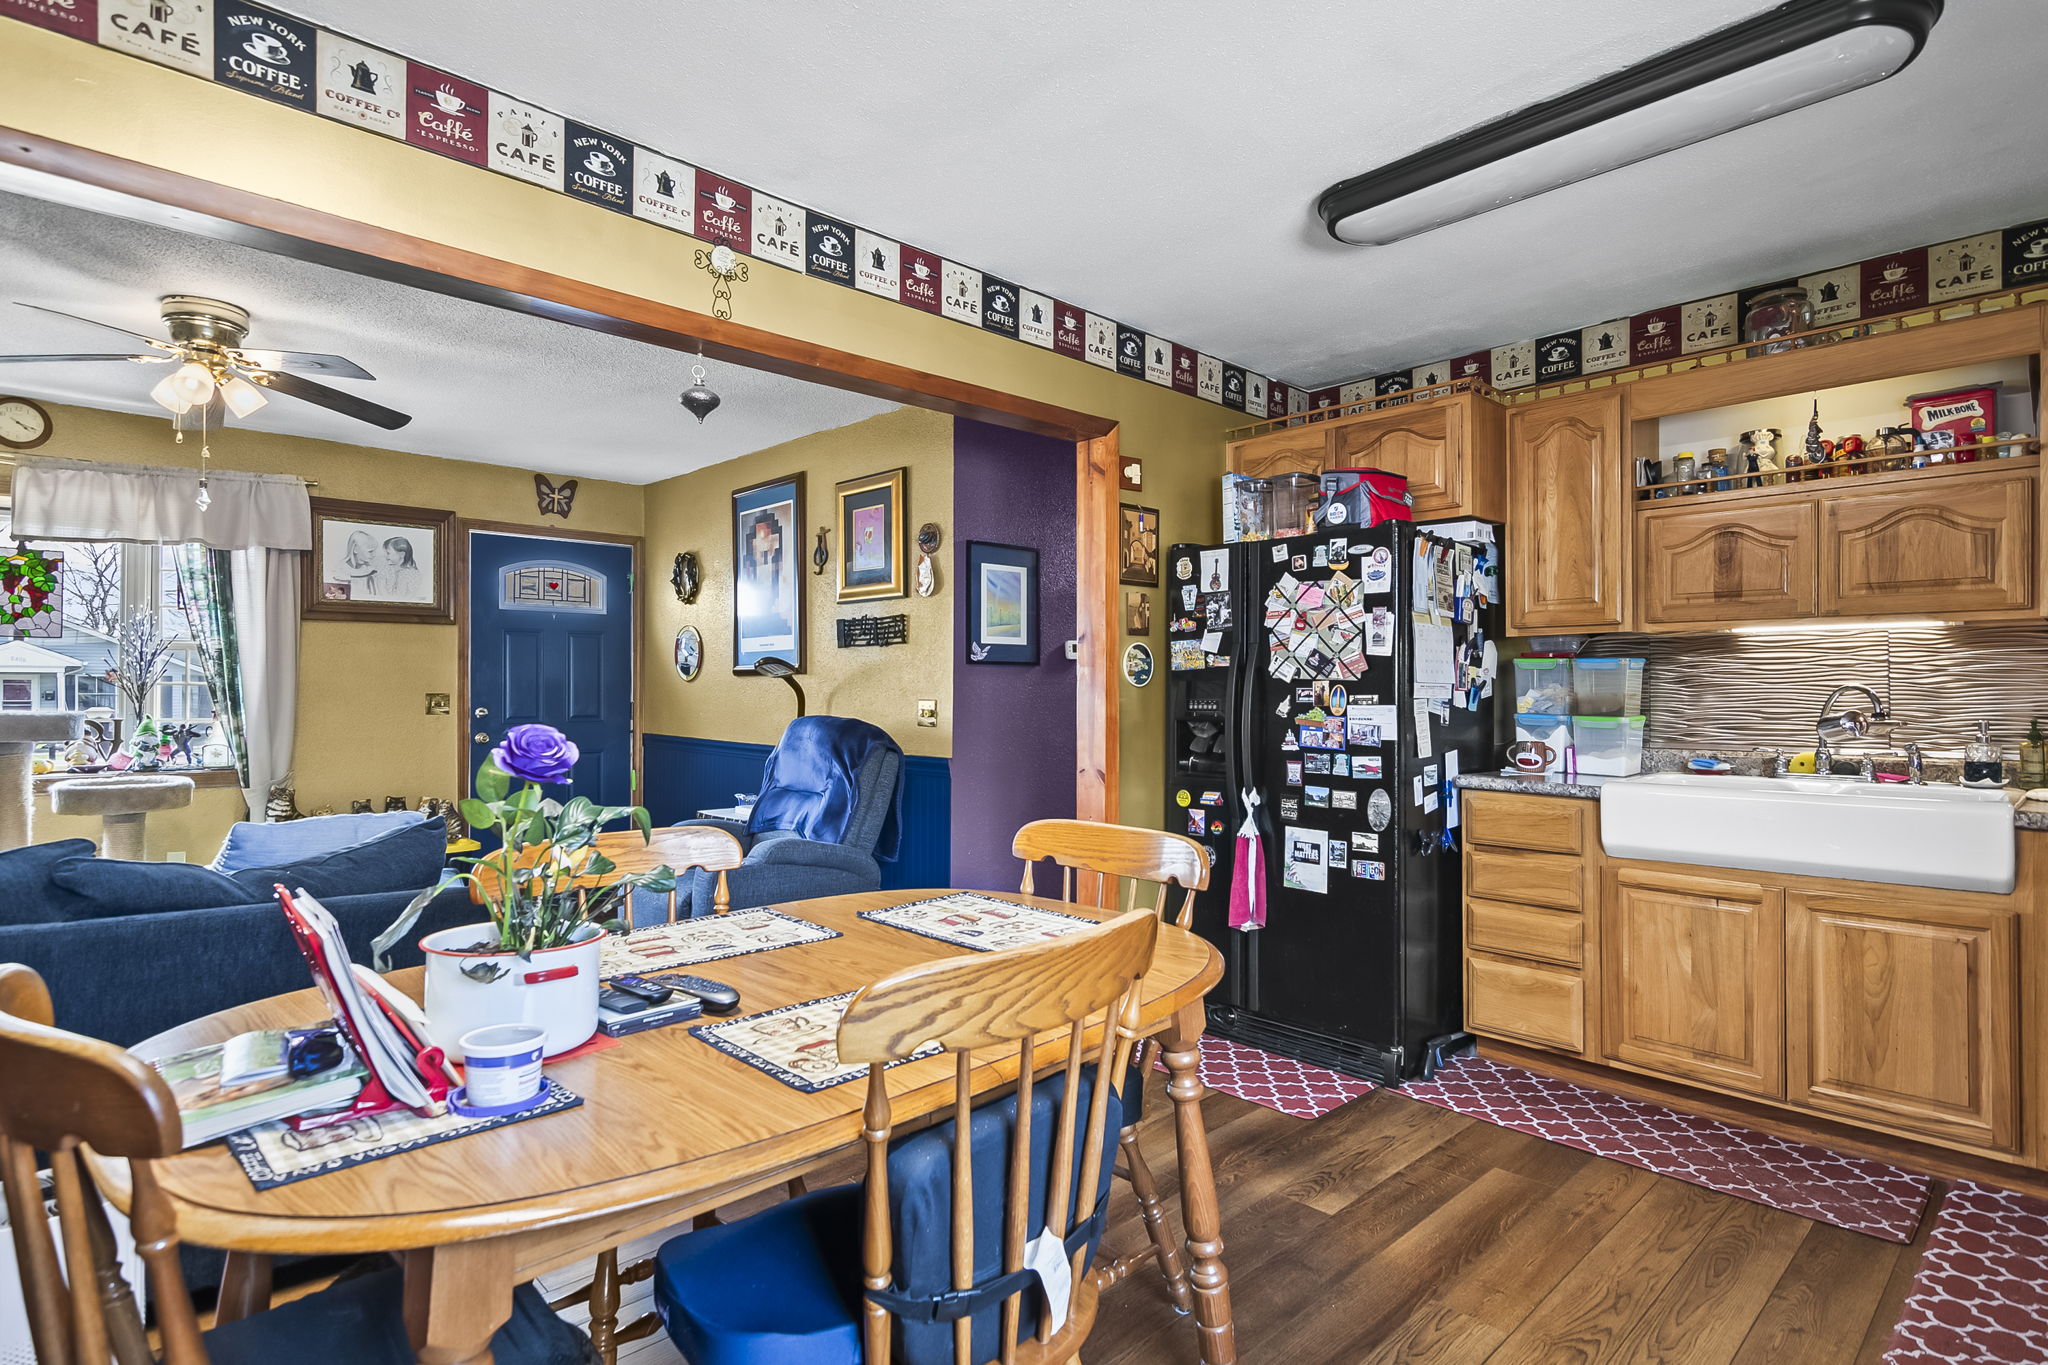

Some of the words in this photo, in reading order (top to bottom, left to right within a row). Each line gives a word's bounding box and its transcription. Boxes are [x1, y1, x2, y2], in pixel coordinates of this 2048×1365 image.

[110, 13, 200, 56] CAFÉ
[227, 15, 264, 27] NEW
[267, 19, 306, 52] YORK
[228, 55, 302, 90] COFFEE
[270, 83, 304, 100] Blend
[325, 89, 381, 114] COFFEE
[417, 111, 474, 142] Caffé
[497, 109, 558, 138] PARIS
[421, 130, 475, 152] ESPRESSO
[496, 142, 556, 174] CAFÉ
[573, 137, 598, 148] NEW
[600, 140, 627, 164] YORK
[574, 171, 623, 197] COFFEE
[639, 195, 678, 214] COFFEE
[703, 210, 741, 234] Caffé
[758, 205, 800, 227] PARIS
[704, 226, 742, 242] ESPRESSO
[811, 224, 830, 234] NEW
[830, 225, 851, 246] YORK
[2012, 229, 2039, 247] NEW
[757, 233, 799, 257] CAFÉ
[812, 254, 848, 273] COFFEE
[859, 270, 888, 285] COFFEE
[1935, 265, 1994, 289] CAFÉ
[906, 278, 934, 298] Caffé
[986, 285, 1000, 294] NEW
[1001, 286, 1016, 303] YORK
[1870, 283, 1915, 302] Caffé
[946, 296, 978, 314] CAFÉ
[987, 311, 1014, 327] COFFEE
[1023, 323, 1044, 336] COFFEE
[1058, 330, 1080, 346] Caffé
[1120, 332, 1130, 340] NEW
[1687, 322, 1731, 342] CAFÉ
[1088, 343, 1114, 359] CAFÉ
[1541, 339, 1557, 352] NEW
[1558, 337, 1577, 346] YORK
[1637, 336, 1671, 352] Caffé
[1120, 355, 1141, 369] COFFEE
[1542, 360, 1575, 374] COFFEE
[1586, 352, 1616, 364] COFFEE
[1147, 365, 1165, 376] COFFEE
[1175, 370, 1193, 384] Caffé
[1496, 364, 1530, 381] CAFÉ
[1200, 380, 1220, 394] CAFÉ
[1380, 378, 1393, 389] NEW
[1394, 376, 1409, 384] YORK
[1225, 390, 1242, 402] COFFEE
